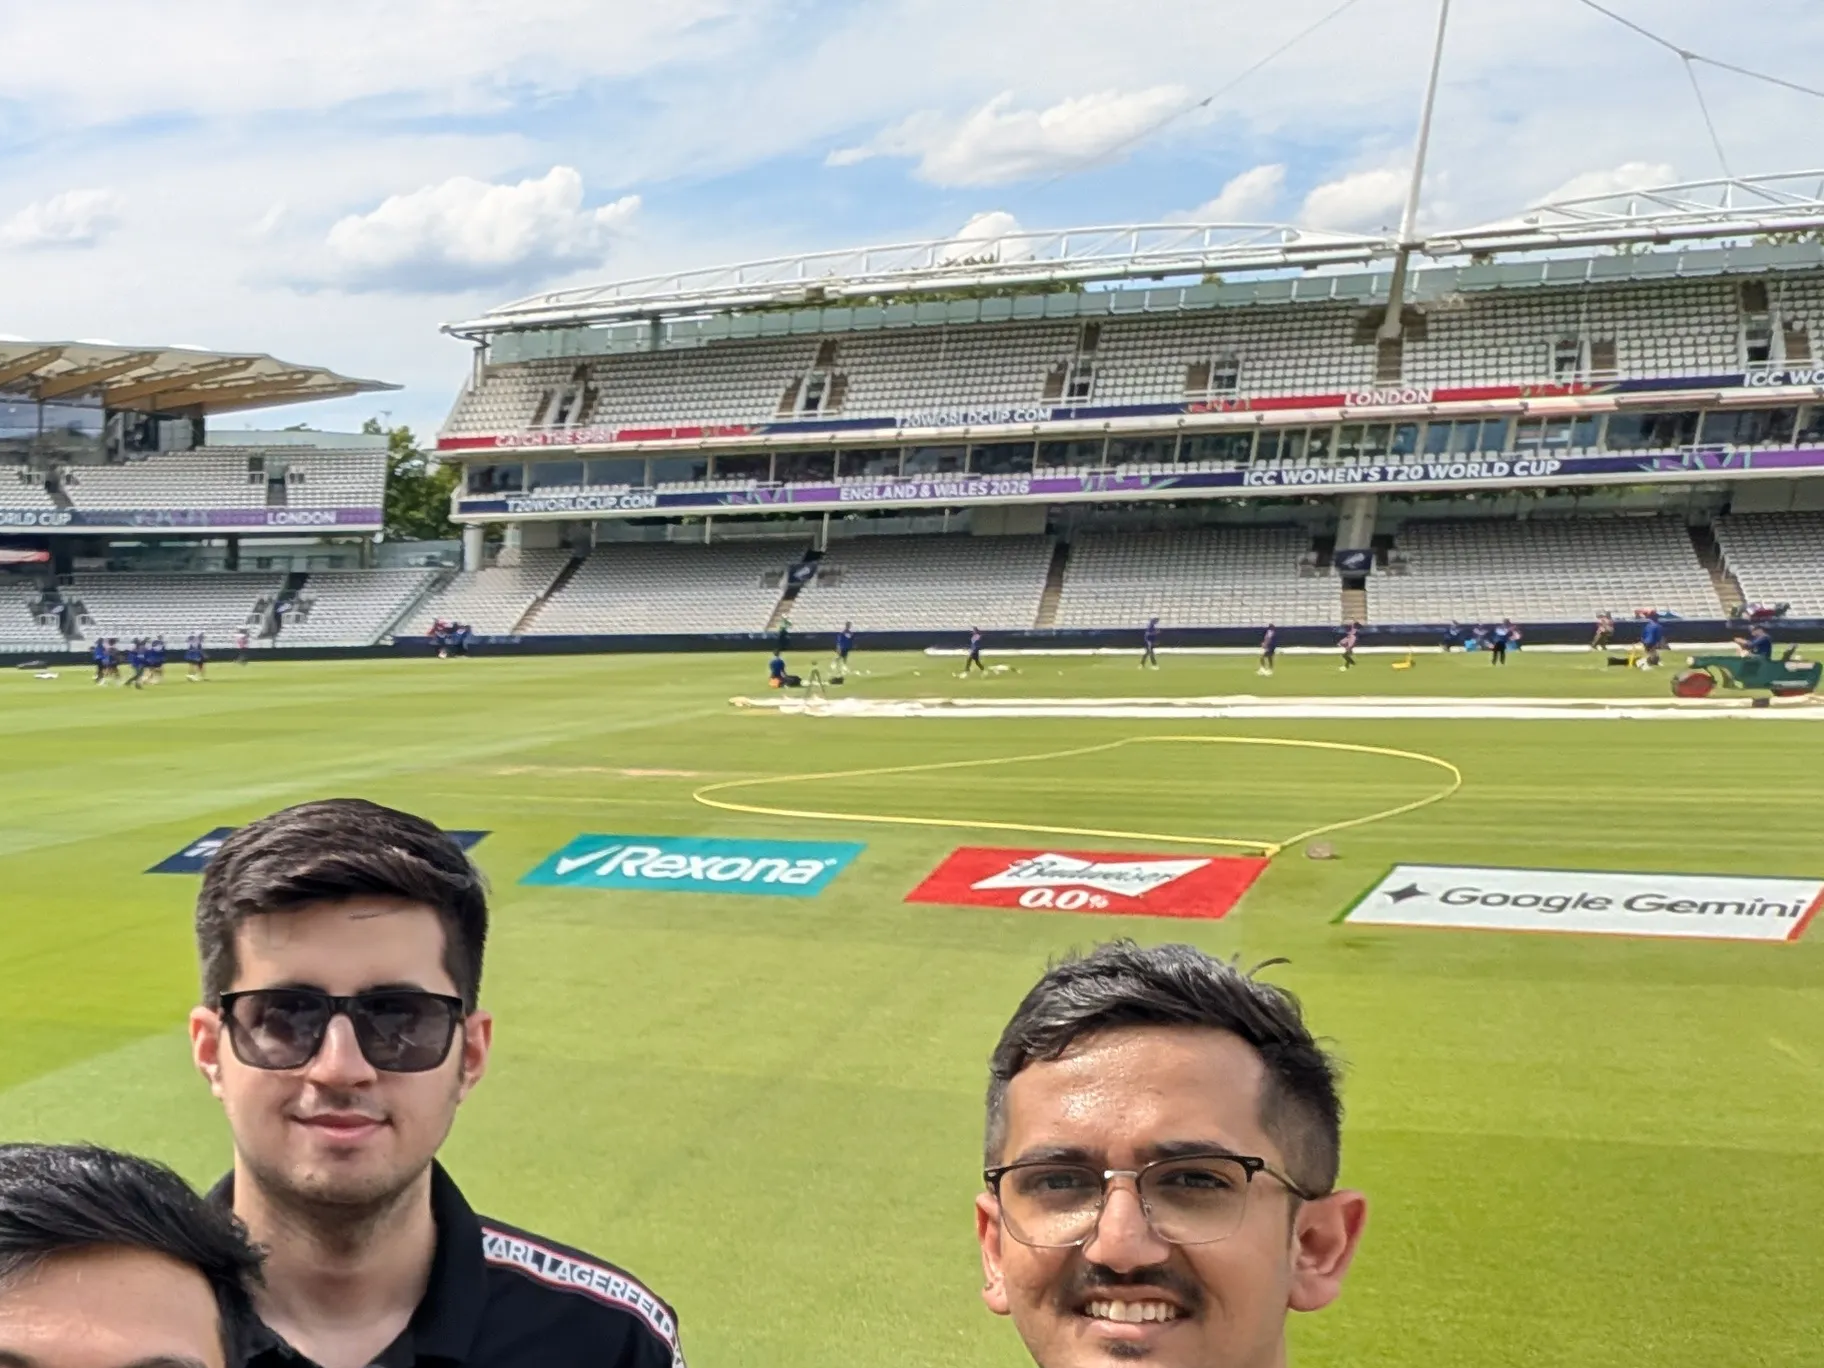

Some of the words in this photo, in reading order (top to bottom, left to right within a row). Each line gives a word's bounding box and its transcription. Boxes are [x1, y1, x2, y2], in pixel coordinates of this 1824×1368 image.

[1743, 370, 1784, 387] ICC
[1344, 389, 1433, 406] LONDON
[895, 408, 1052, 428] T20WORLDCUP.COM
[496, 431, 542, 447] CATCH
[545, 430, 573, 445] THE
[1243, 472, 1278, 486] ICC
[1281, 466, 1381, 485] WOMEN'S
[1385, 464, 1423, 481] T20
[1427, 462, 1509, 479] WORLD
[1513, 460, 1561, 476] CUP
[840, 485, 916, 500] ENGLAND
[920, 484, 930, 497] &
[934, 481, 988, 498] WALES
[990, 480, 1030, 495] 2026
[507, 495, 657, 512] T20WORLDCUP.COM
[38, 512, 72, 526] CUP
[267, 511, 337, 525] LONDON
[595, 845, 824, 884] Rexona
[1440, 886, 1613, 914] Google
[1624, 893, 1806, 919] Gemini
[542, 1251, 674, 1342] LAGERFELD
